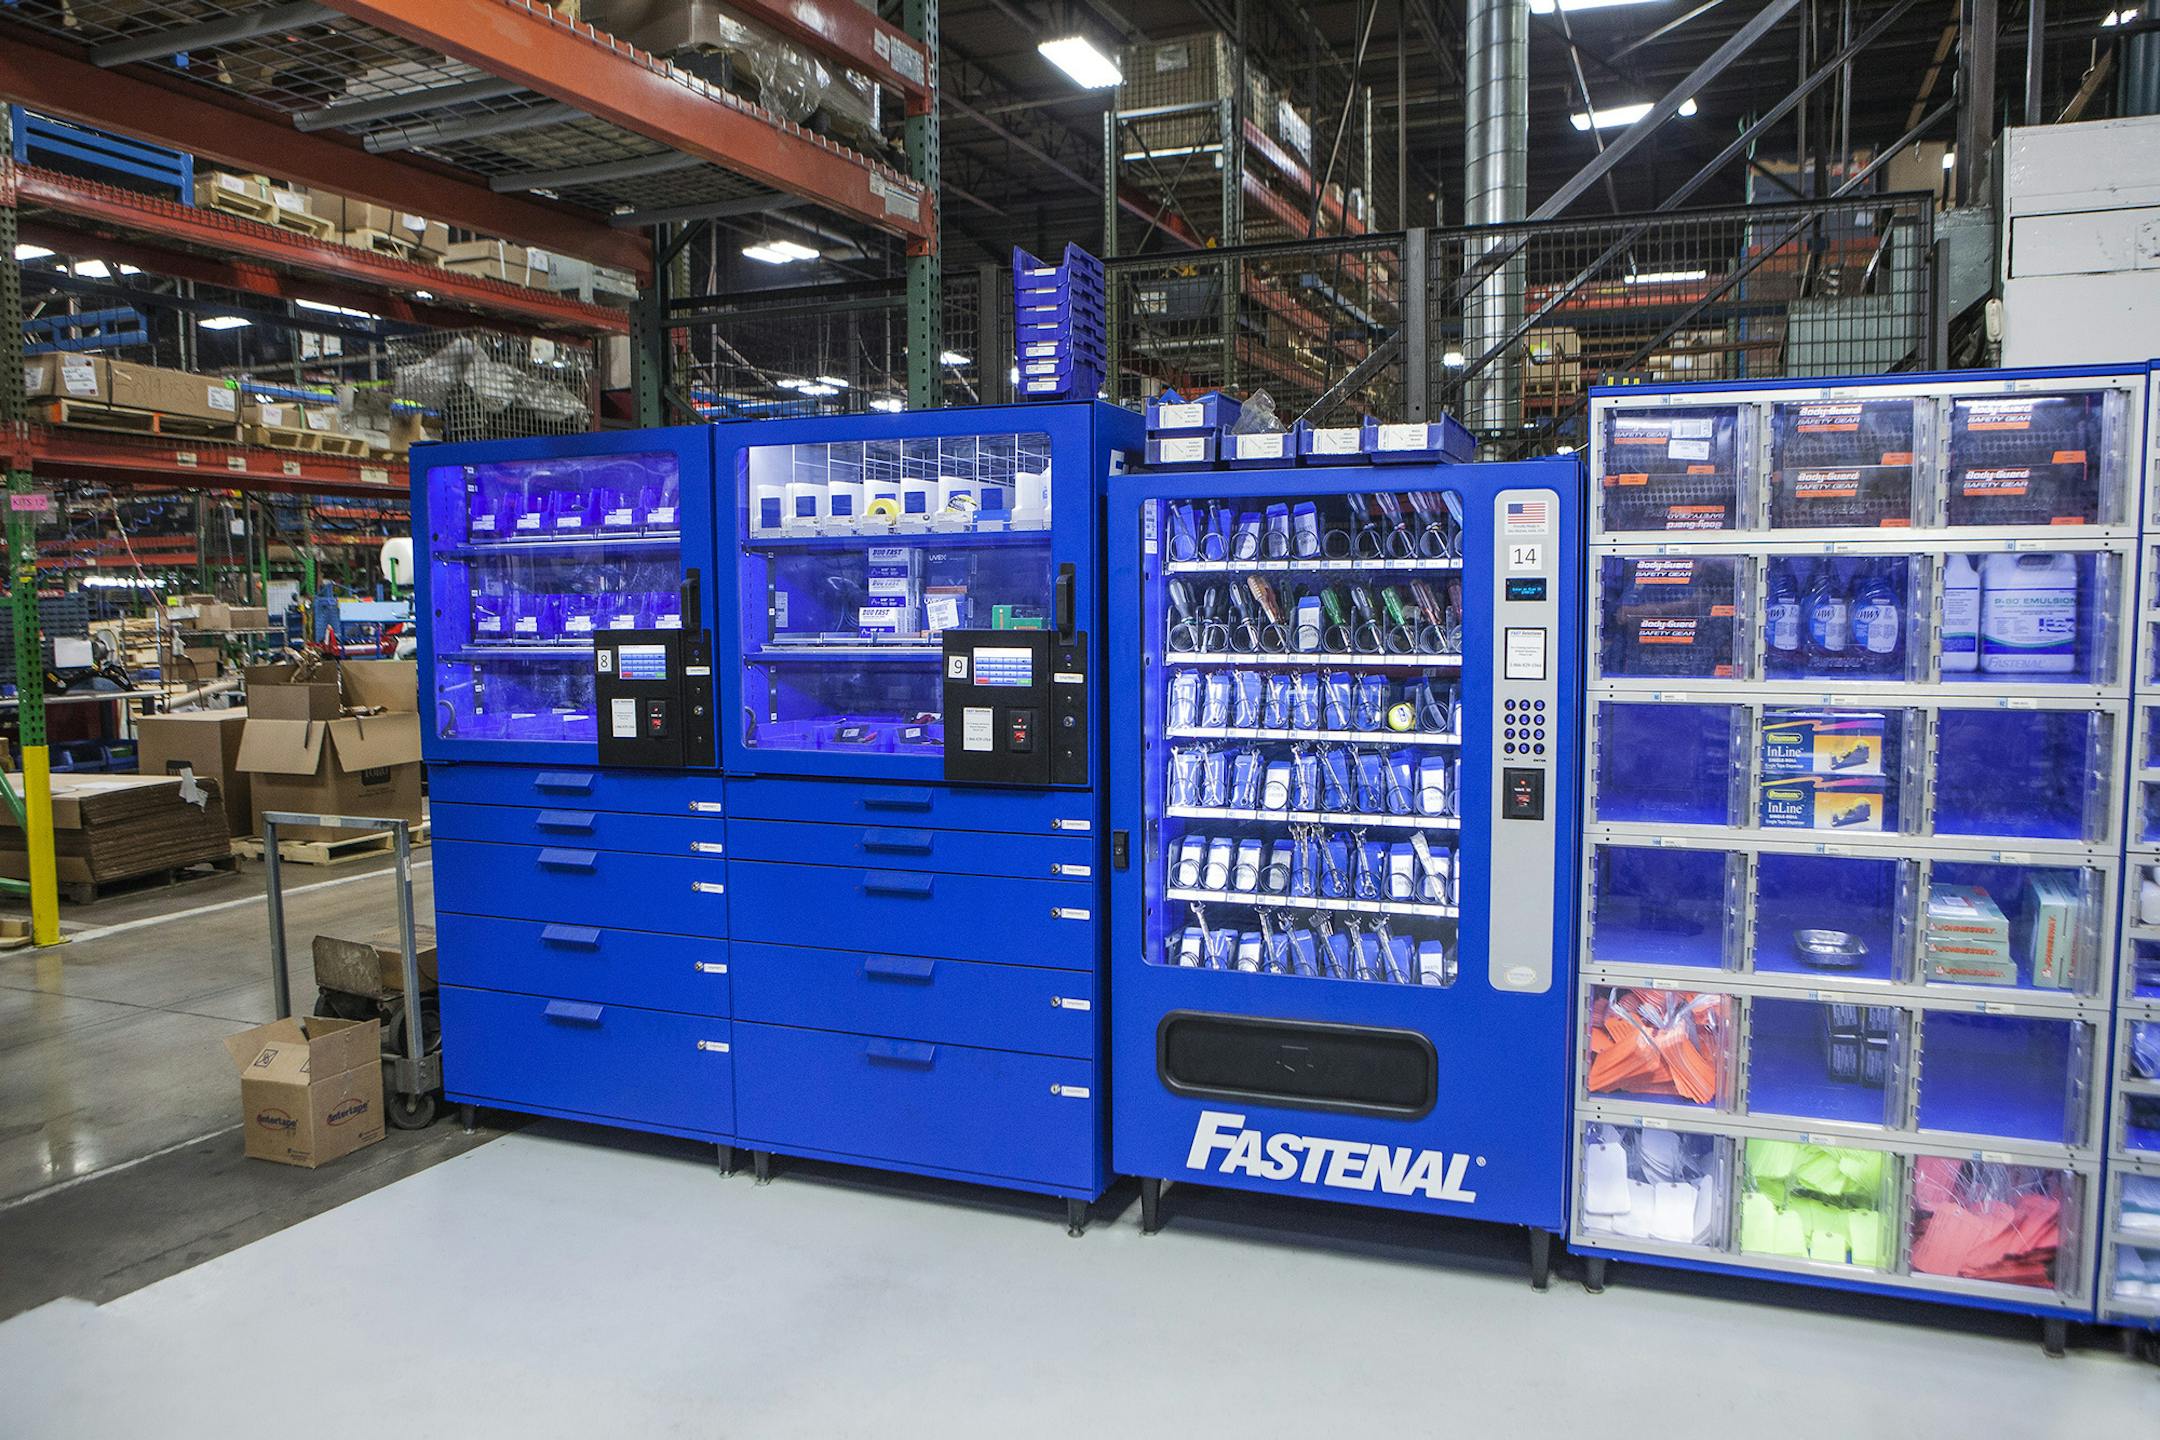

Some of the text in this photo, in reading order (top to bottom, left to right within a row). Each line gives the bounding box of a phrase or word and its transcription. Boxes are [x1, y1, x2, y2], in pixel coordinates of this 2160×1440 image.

[1797, 416, 1860, 426] SAFETY GEAR
[1967, 414, 2032, 423] SAFETY GEAR
[1831, 482, 1859, 490] GEAR
[1963, 480, 2029, 489] SAFETY GEAR
[1513, 548, 1537, 565] 14
[600, 654, 608, 668] 8
[953, 659, 964, 674] 9
[1987, 656, 2045, 669] FASTENAL
[1766, 745, 1801, 758] InLine
[1767, 801, 1803, 814] InLine
[1186, 1109, 1477, 1204] FASTENAL
